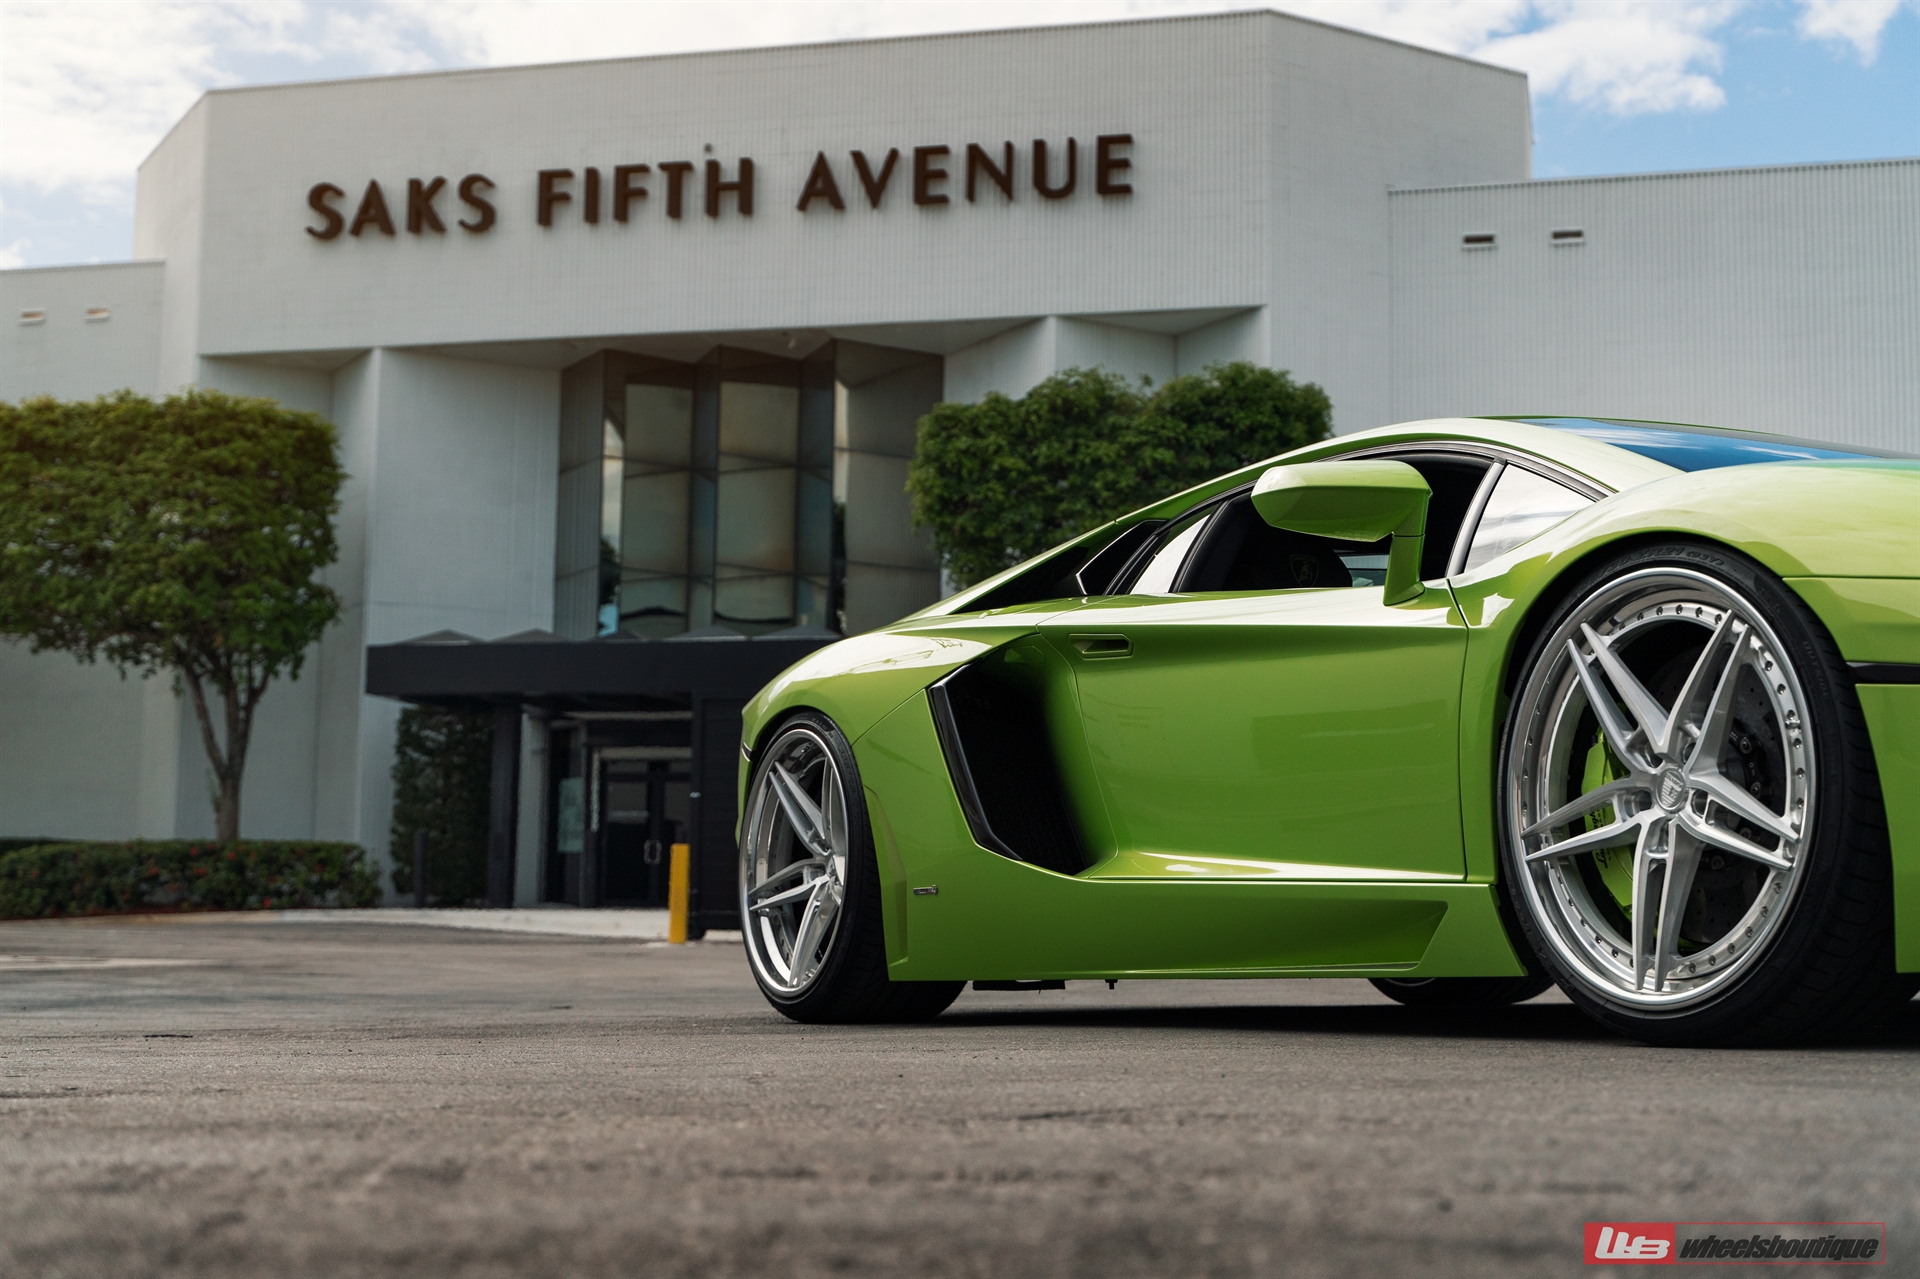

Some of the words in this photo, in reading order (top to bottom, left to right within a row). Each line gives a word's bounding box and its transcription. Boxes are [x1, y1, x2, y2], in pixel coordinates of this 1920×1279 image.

[306, 173, 497, 242] SAKS
[536, 157, 756, 229] FIFTH
[797, 133, 1135, 213] AVENUE
